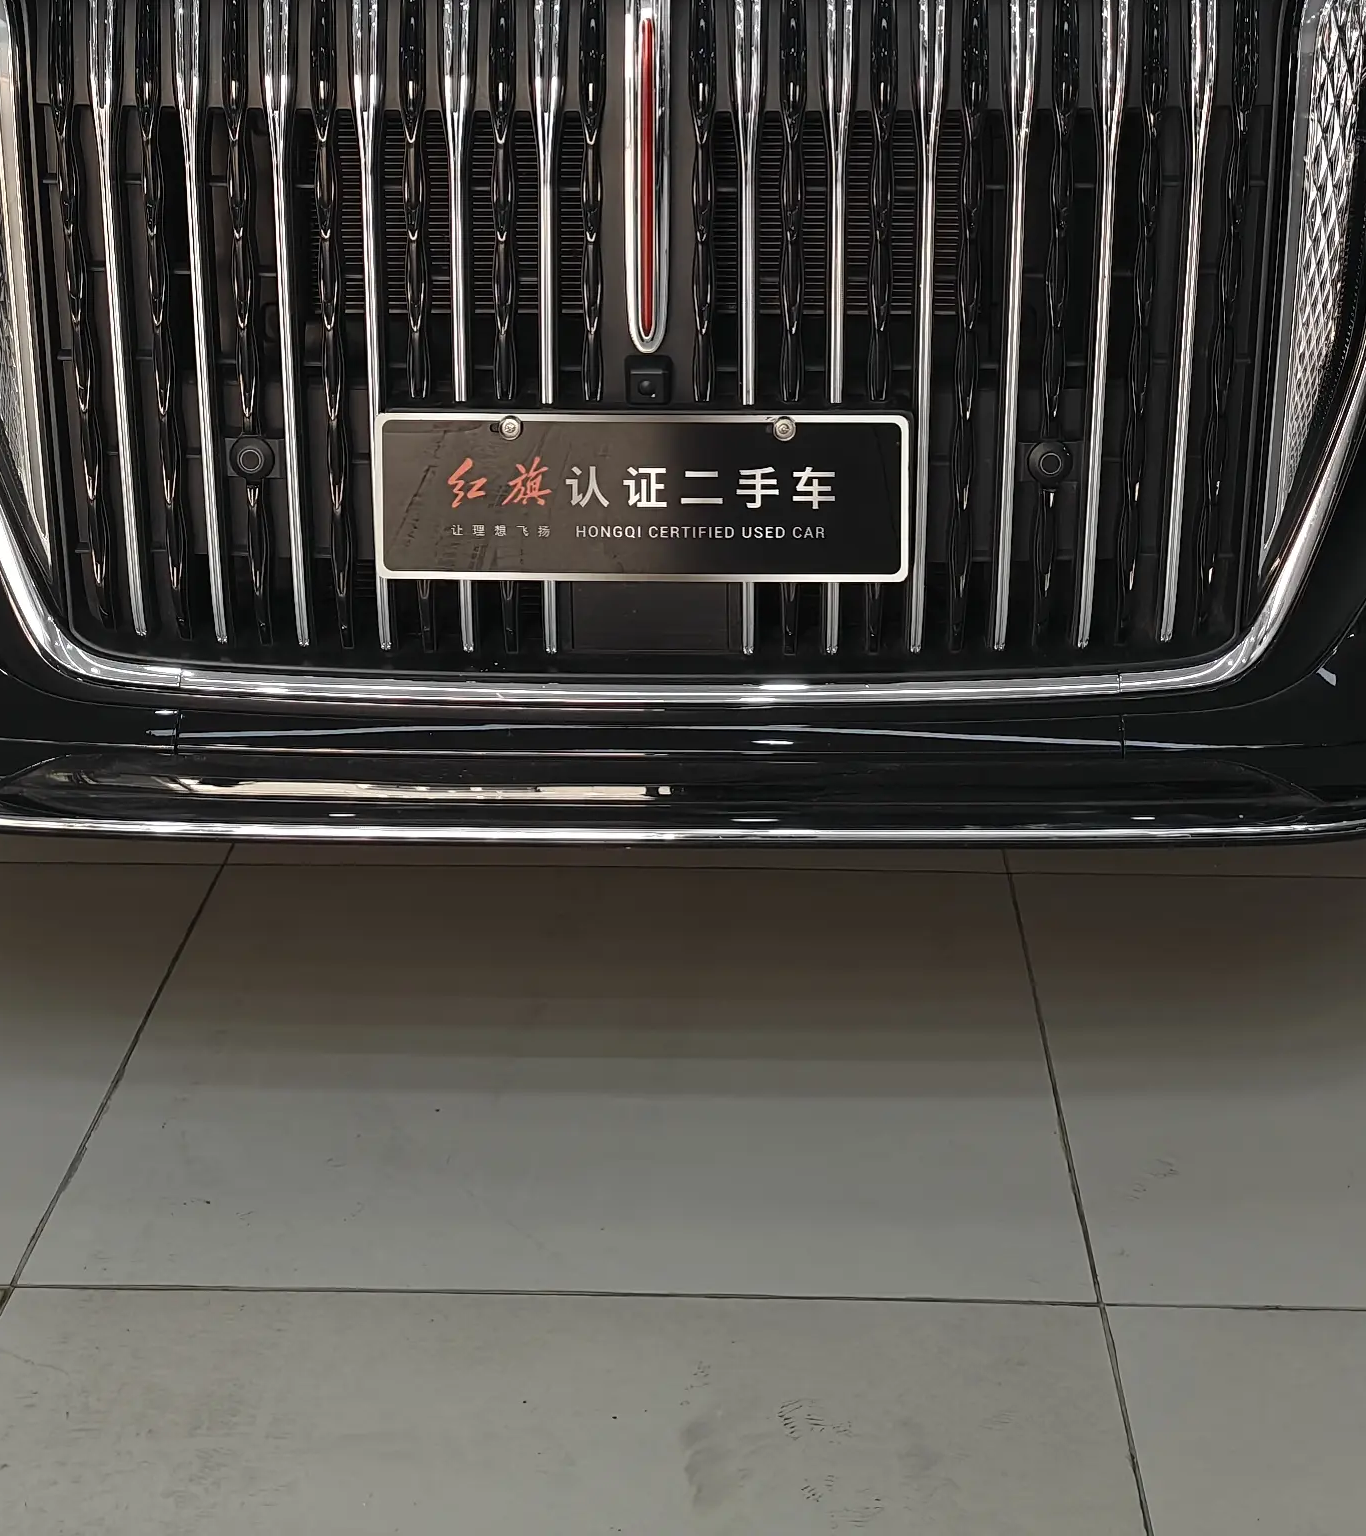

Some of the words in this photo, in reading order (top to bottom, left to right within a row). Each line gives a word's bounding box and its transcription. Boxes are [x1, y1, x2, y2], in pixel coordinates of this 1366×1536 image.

[447, 457, 837, 510] 红旗认证二手车
[450, 524, 552, 538] 让理想飞扬
[575, 525, 643, 540] HONGQI
[648, 525, 735, 540] CERTIFIED
[741, 525, 786, 539] USED
[791, 525, 826, 539] CAR
